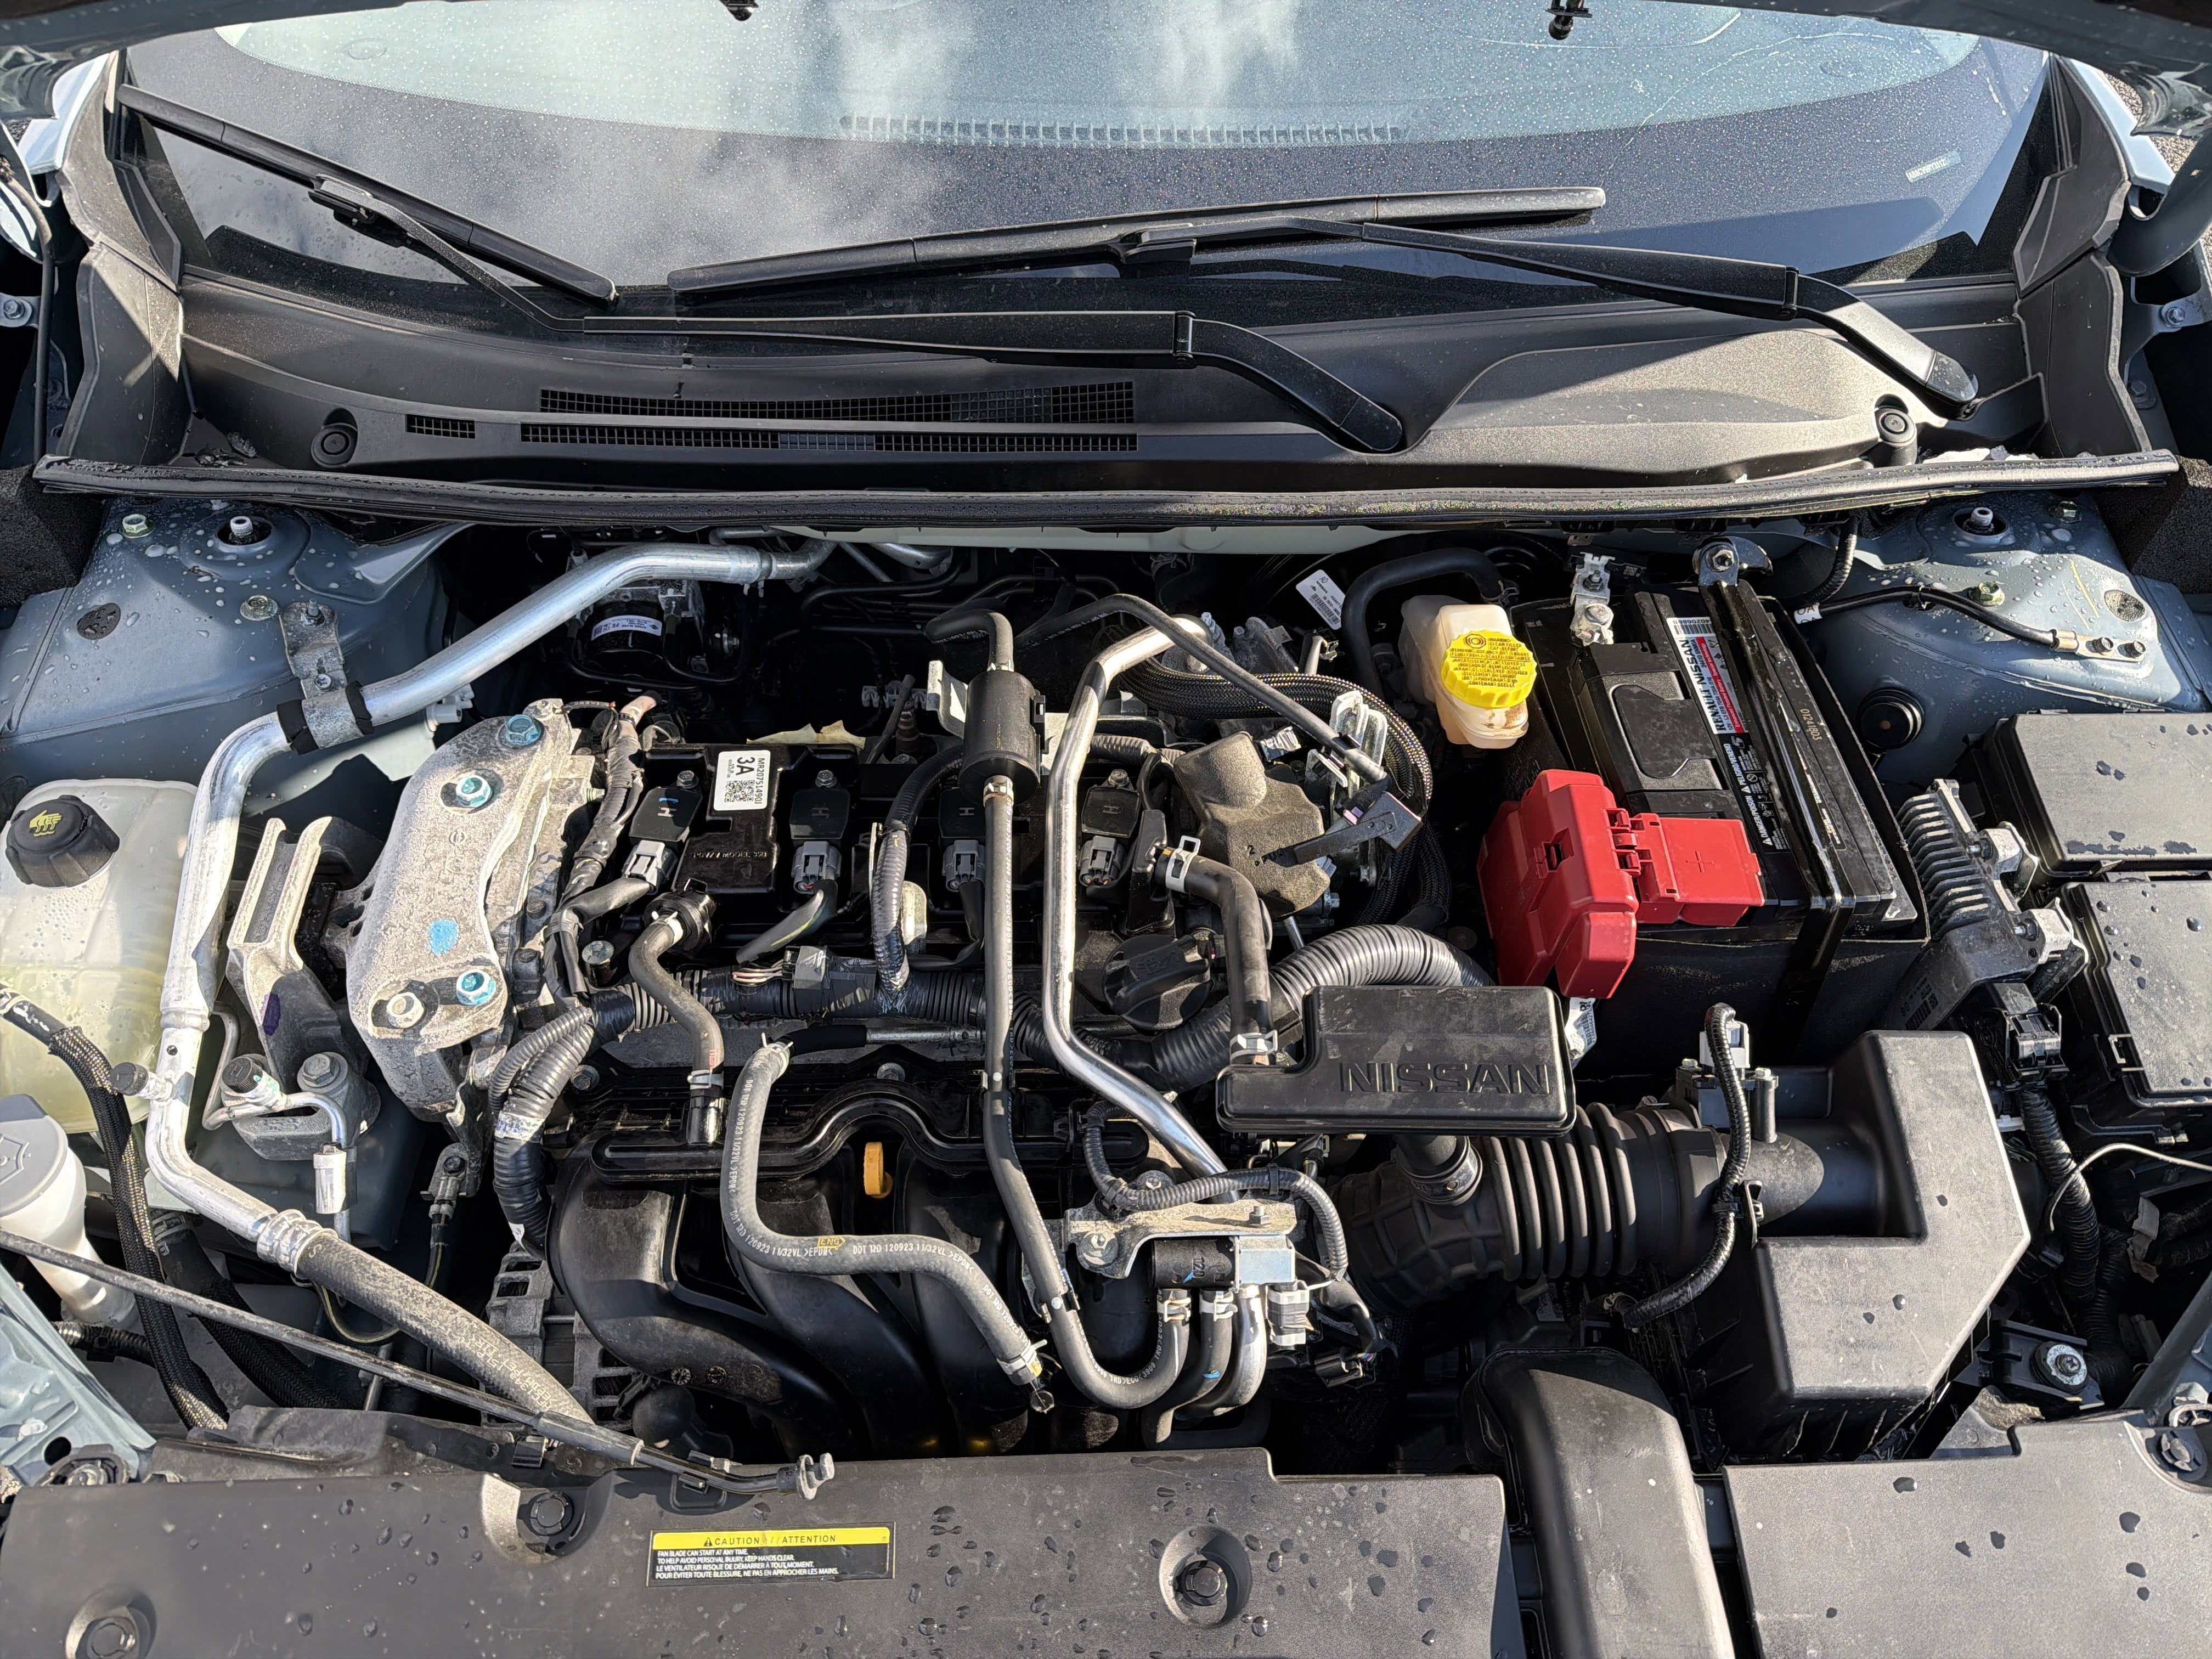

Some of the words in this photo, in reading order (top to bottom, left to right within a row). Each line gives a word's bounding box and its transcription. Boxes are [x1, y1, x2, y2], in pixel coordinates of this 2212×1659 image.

[1679, 640, 1707, 685] NISSAN
[1709, 663, 1719, 676] Special
[1717, 679, 1728, 693] Battery
[1700, 689, 1726, 731] RENAULT
[1723, 693, 1734, 707] Flooded
[1729, 707, 1740, 728] Enhanced
[1798, 708, 1823, 741] 01241803
[736, 757, 755, 776] 3A
[754, 757, 765, 804] MR20751490J
[1745, 795, 1769, 838] DANGER/POISON
[1340, 1062, 1550, 1094] NISSAN
[735, 1109, 746, 1135] 120923
[730, 1209, 741, 1224] DOT
[744, 1234, 770, 1254] 120923
[820, 1237, 840, 1245] ENG
[853, 1245, 866, 1255] DOT
[885, 1243, 913, 1252] 120923
[510, 1371, 552, 1411] HFC134a
[715, 1537, 760, 1546] CAUTION
[782, 1534, 836, 1544] ATTENTION
